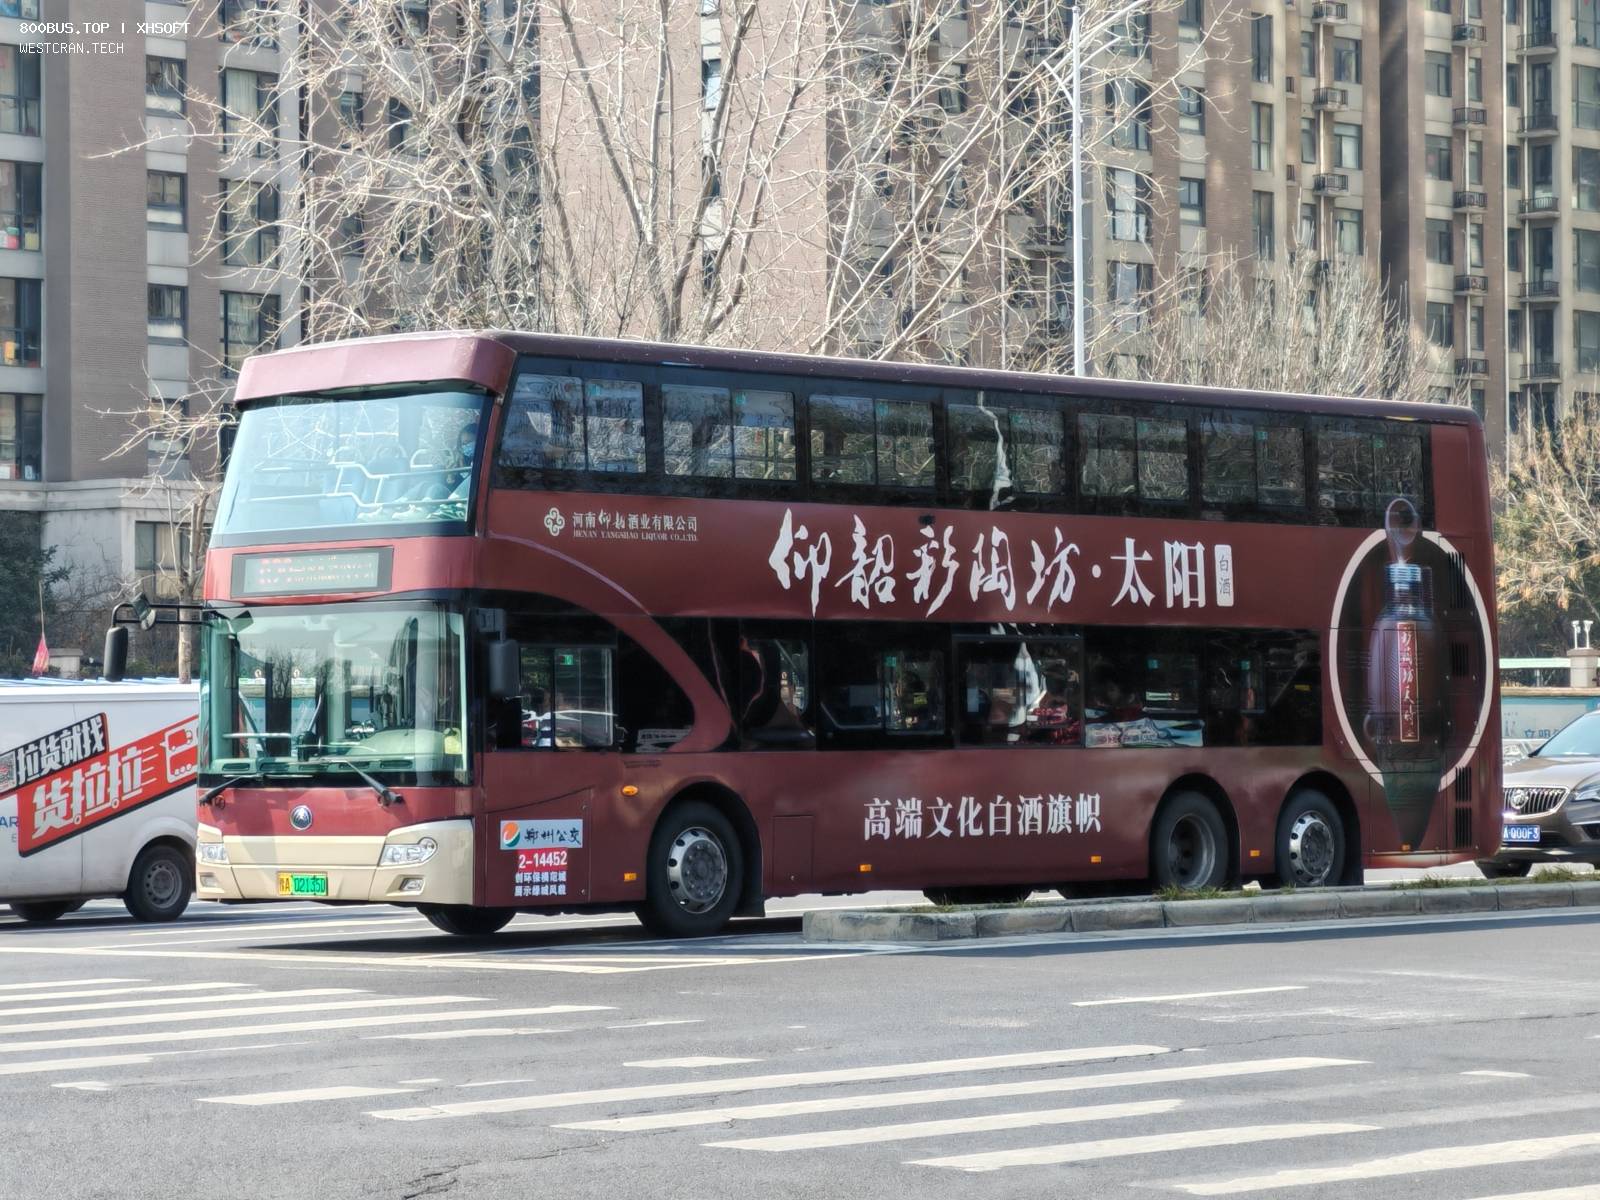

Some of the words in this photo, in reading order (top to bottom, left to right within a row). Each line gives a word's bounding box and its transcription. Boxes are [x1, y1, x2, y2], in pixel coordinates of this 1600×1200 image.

[573, 529, 598, 539] HENAN
[641, 531, 668, 541] LIQUOR
[1218, 554, 1231, 597] 白酒
[17, 715, 105, 785] 拉货就找
[32, 746, 143, 840] 货拉拉
[863, 793, 1102, 841] 高端文化白酒旗帜
[518, 850, 568, 869] 2-14452
